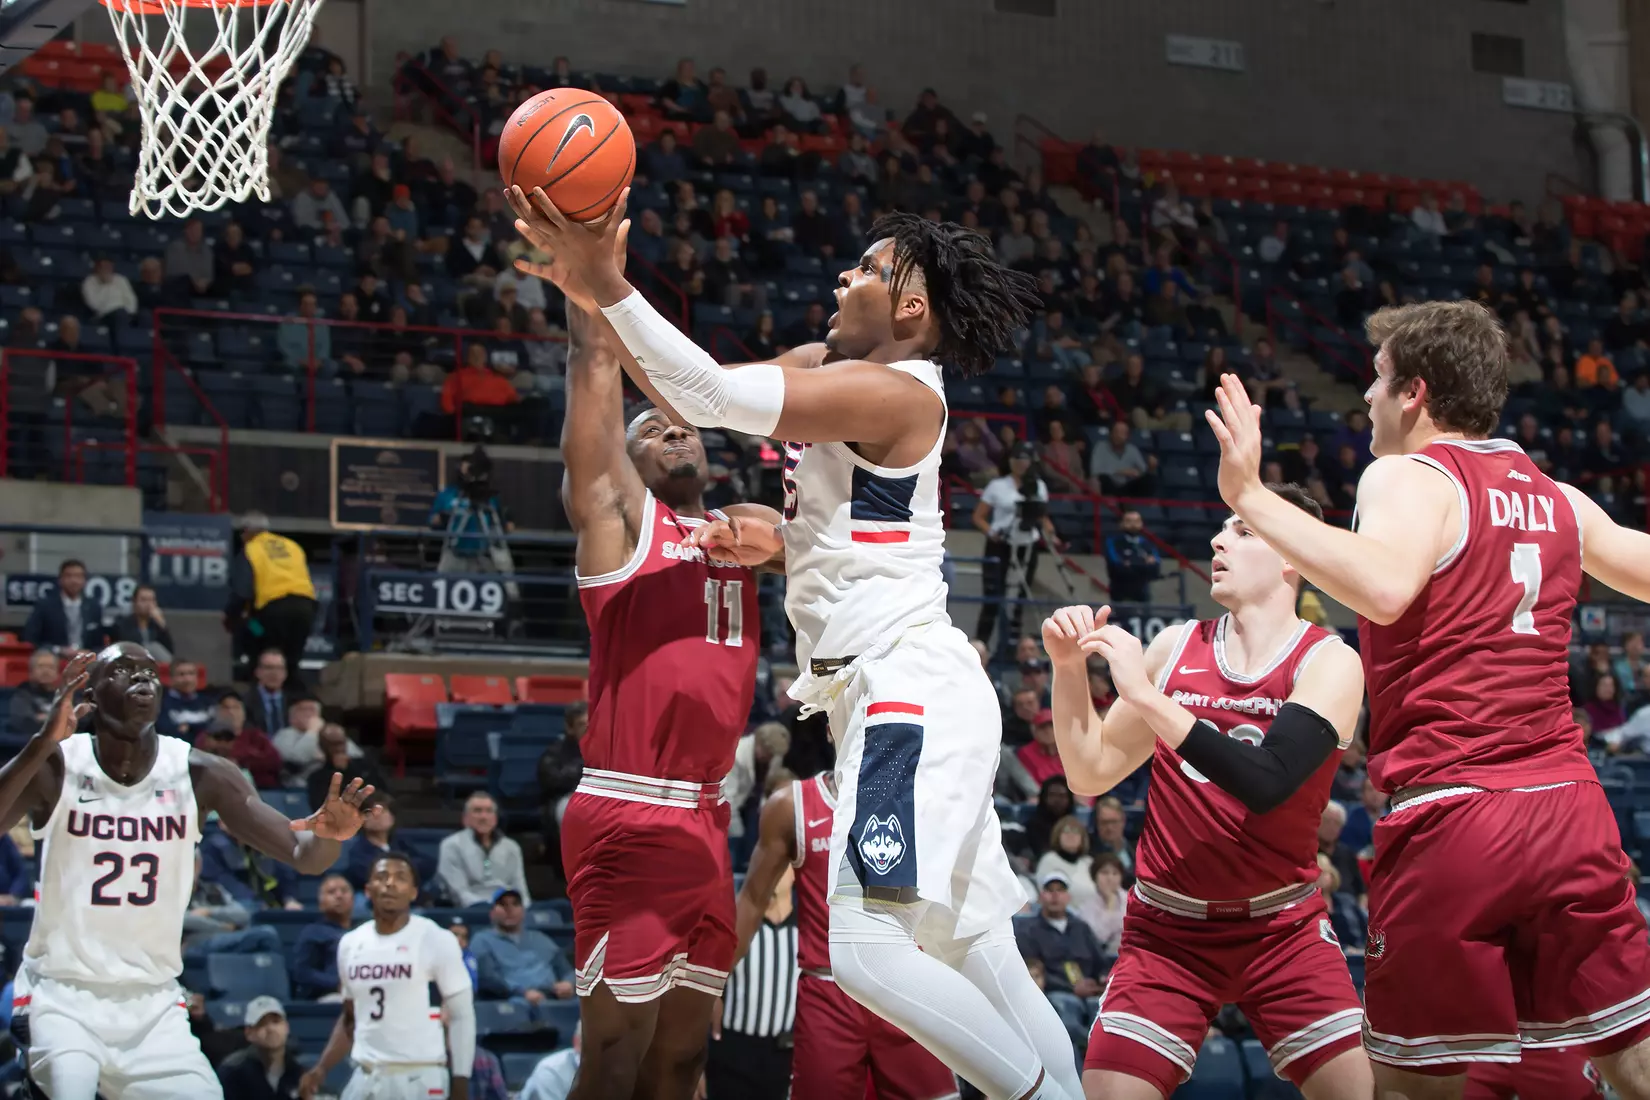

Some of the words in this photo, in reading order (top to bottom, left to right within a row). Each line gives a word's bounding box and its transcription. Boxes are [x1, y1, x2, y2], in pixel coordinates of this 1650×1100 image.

[1487, 488, 1557, 533] DALY
[149, 554, 228, 586] LUB
[379, 581, 424, 603] SEC
[432, 578, 504, 614] 109
[1510, 542, 1543, 636] 1
[704, 577, 743, 648] 11
[67, 809, 187, 842] UCONN
[90, 851, 160, 907] 23
[348, 964, 412, 980] UCONN
[369, 986, 385, 1020] 3
